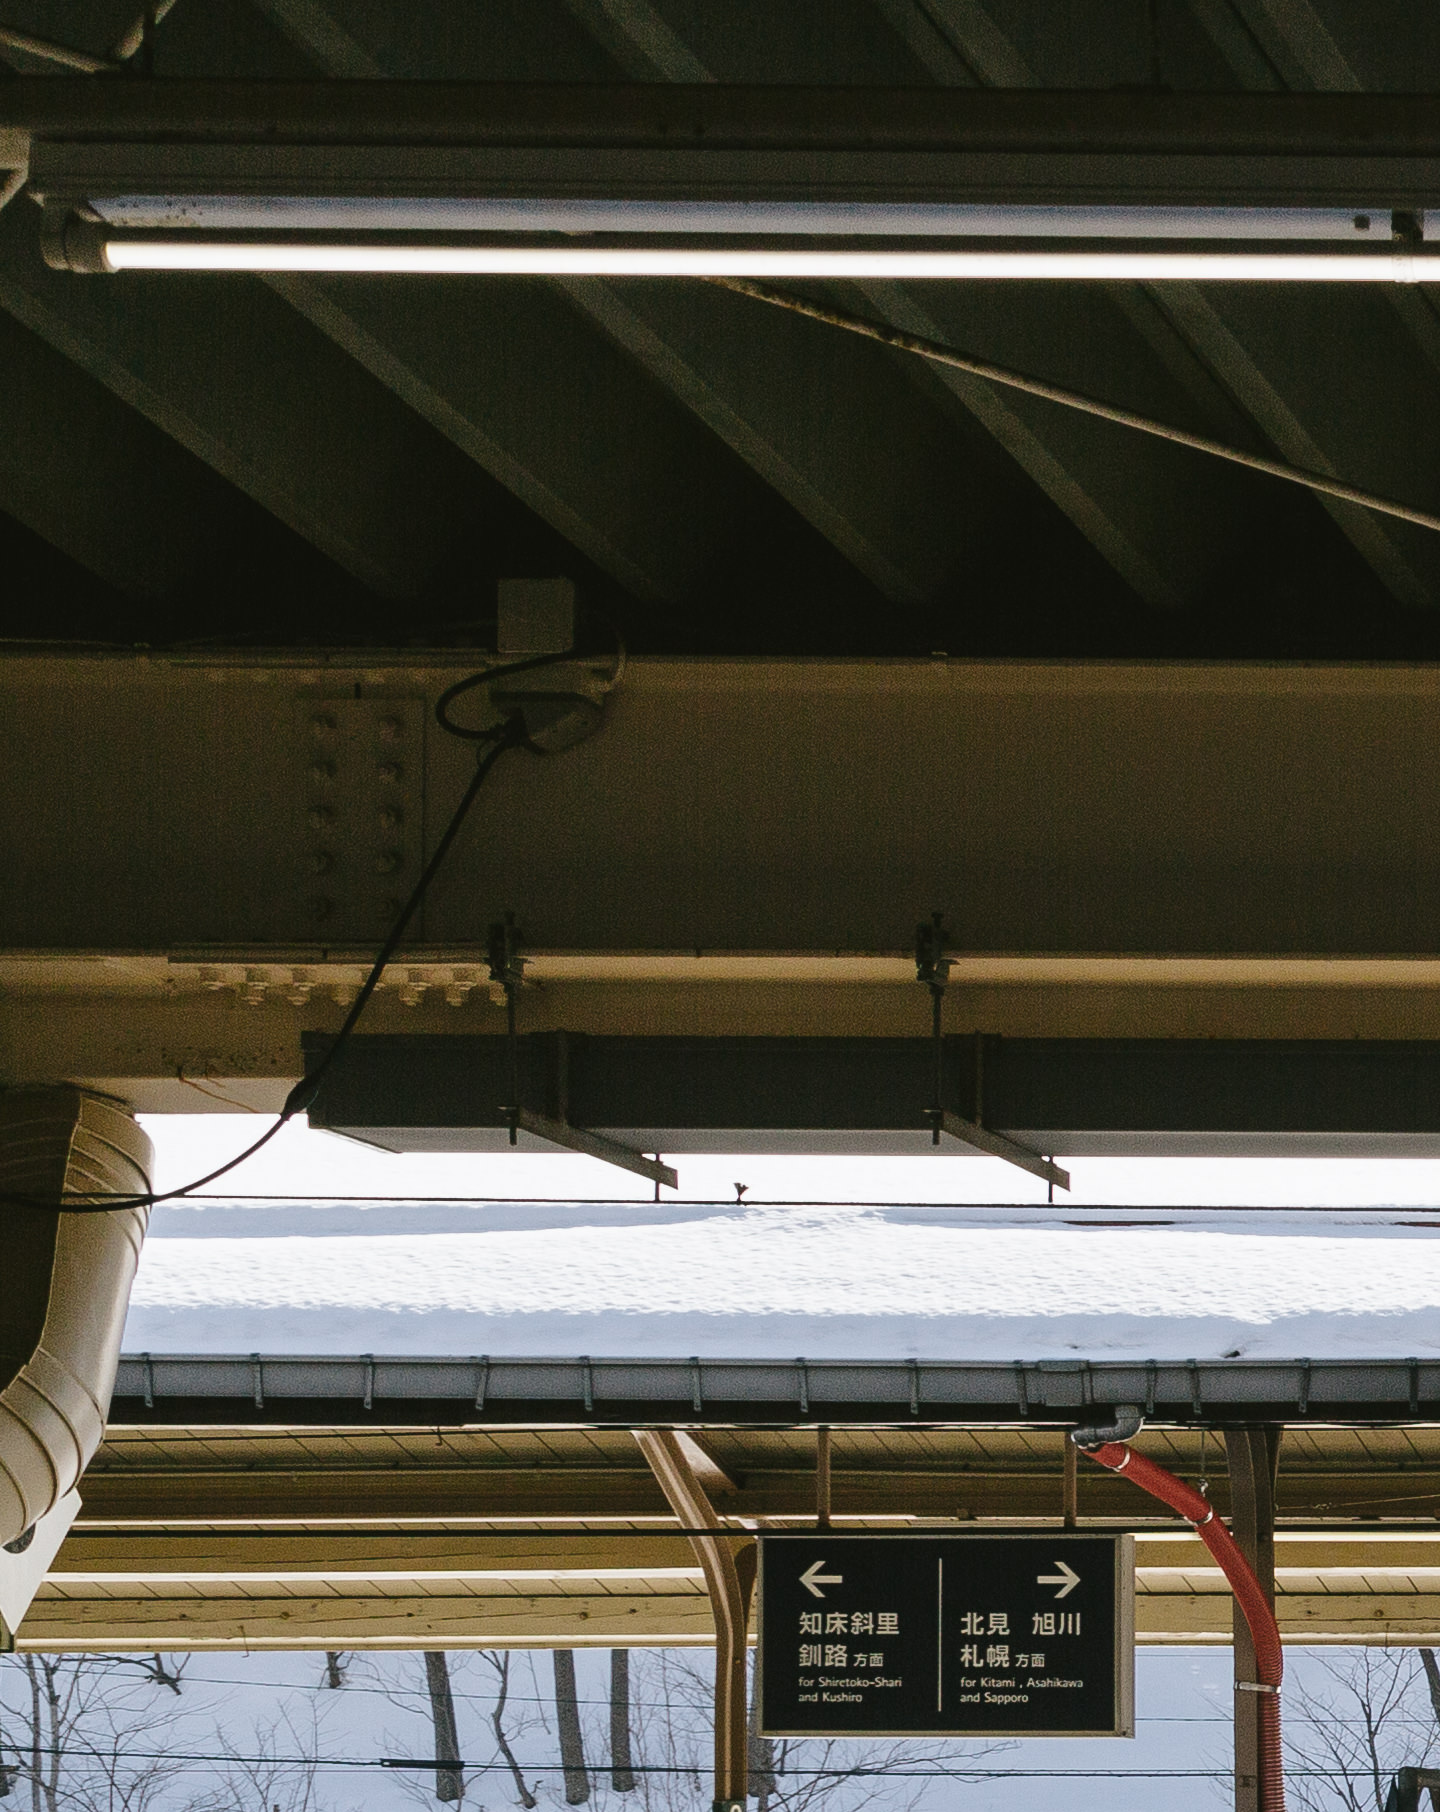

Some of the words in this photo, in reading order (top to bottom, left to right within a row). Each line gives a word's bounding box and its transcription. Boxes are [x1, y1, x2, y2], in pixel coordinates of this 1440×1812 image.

[798, 1611, 900, 1636] 知床斜里
[960, 1611, 1011, 1636] 北見
[1031, 1611, 1082, 1636] 旭川
[798, 1643, 849, 1668] 釧路
[852, 1652, 884, 1668] 方面
[960, 1643, 1010, 1668] 札幌
[1015, 1652, 1046, 1668] 方面
[798, 1676, 815, 1688] for
[818, 1676, 903, 1688] Shiretoko-Shari
[960, 1676, 977, 1688] for
[980, 1676, 1016, 1688] Kitami
[1026, 1677, 1084, 1688] Asahikawa
[798, 1692, 819, 1703] and
[822, 1692, 863, 1703] Kushiro
[960, 1692, 980, 1703] and
[984, 1692, 1029, 1706] Sapporo
